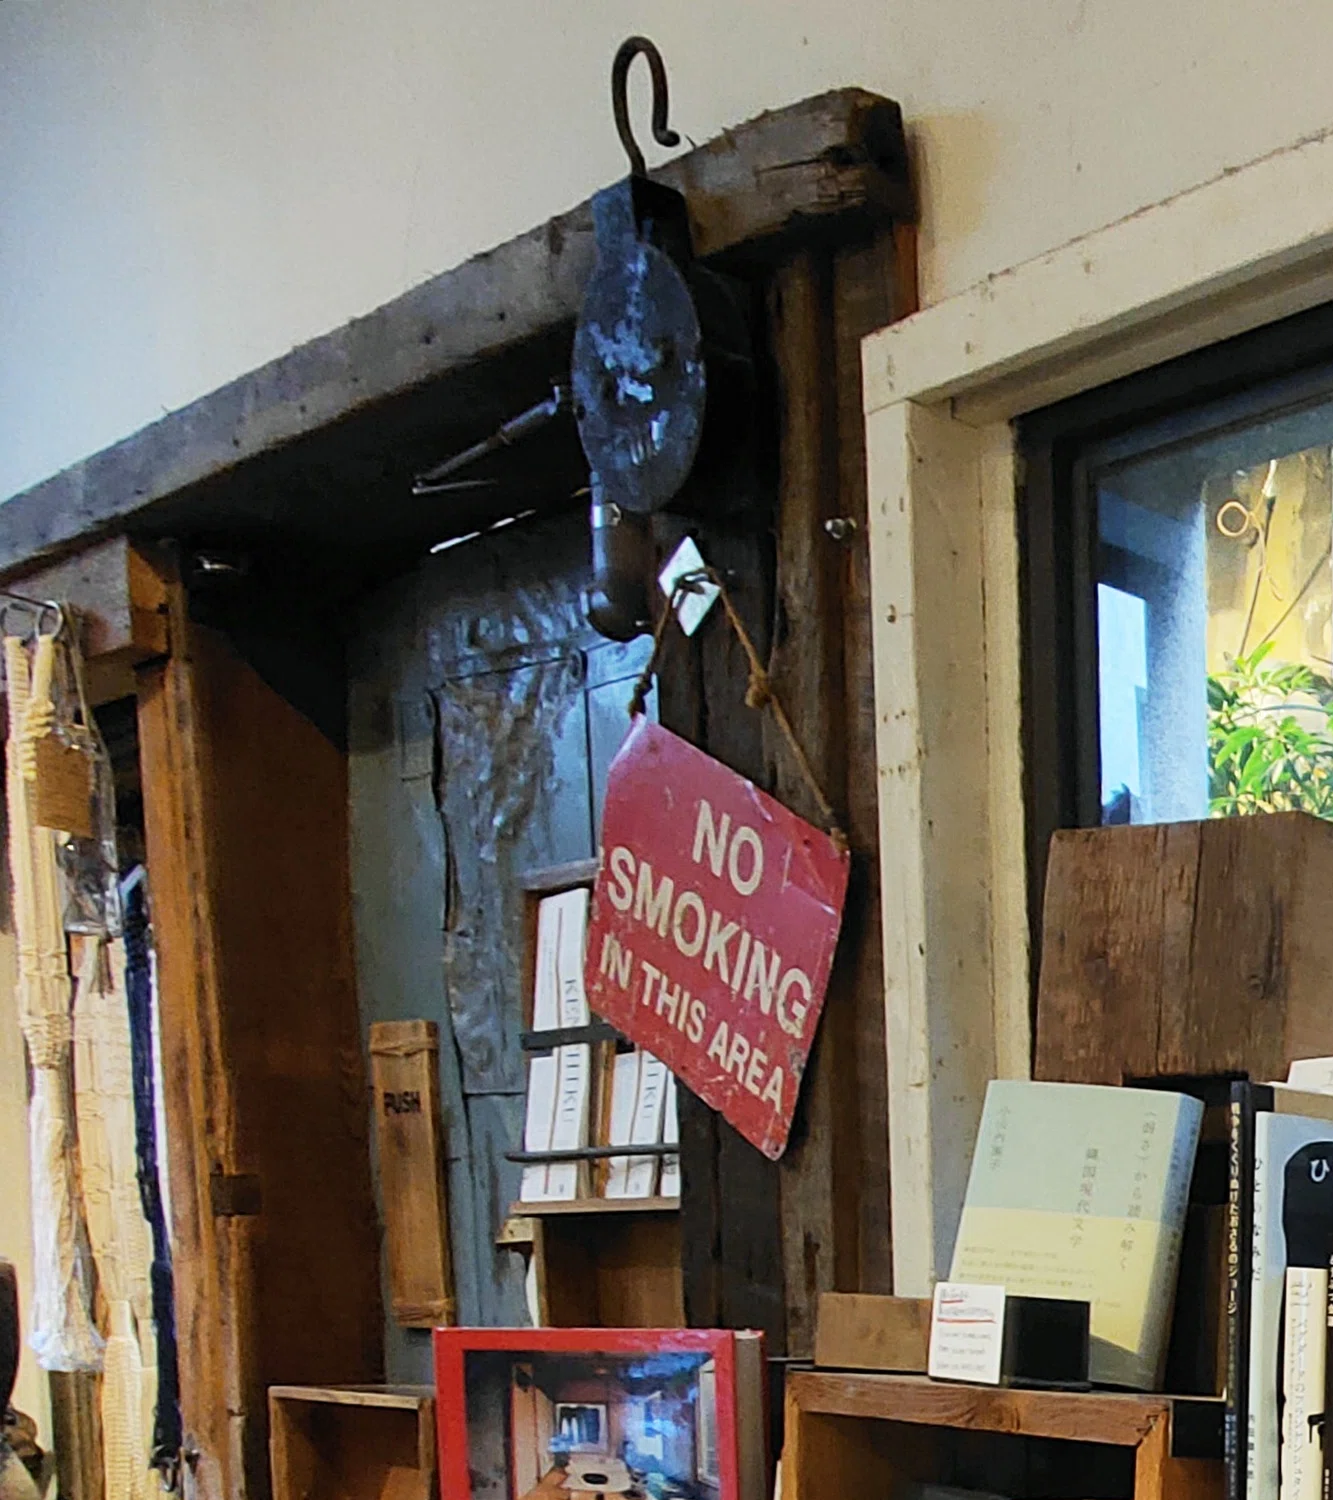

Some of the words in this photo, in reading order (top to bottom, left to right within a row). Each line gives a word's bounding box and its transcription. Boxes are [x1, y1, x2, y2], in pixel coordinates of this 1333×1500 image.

[692, 798, 764, 896] NO
[599, 933, 633, 990] IN
[640, 961, 706, 1044] THIS
[705, 1020, 784, 1113] AREA
[607, 845, 812, 1039] SMOKING
